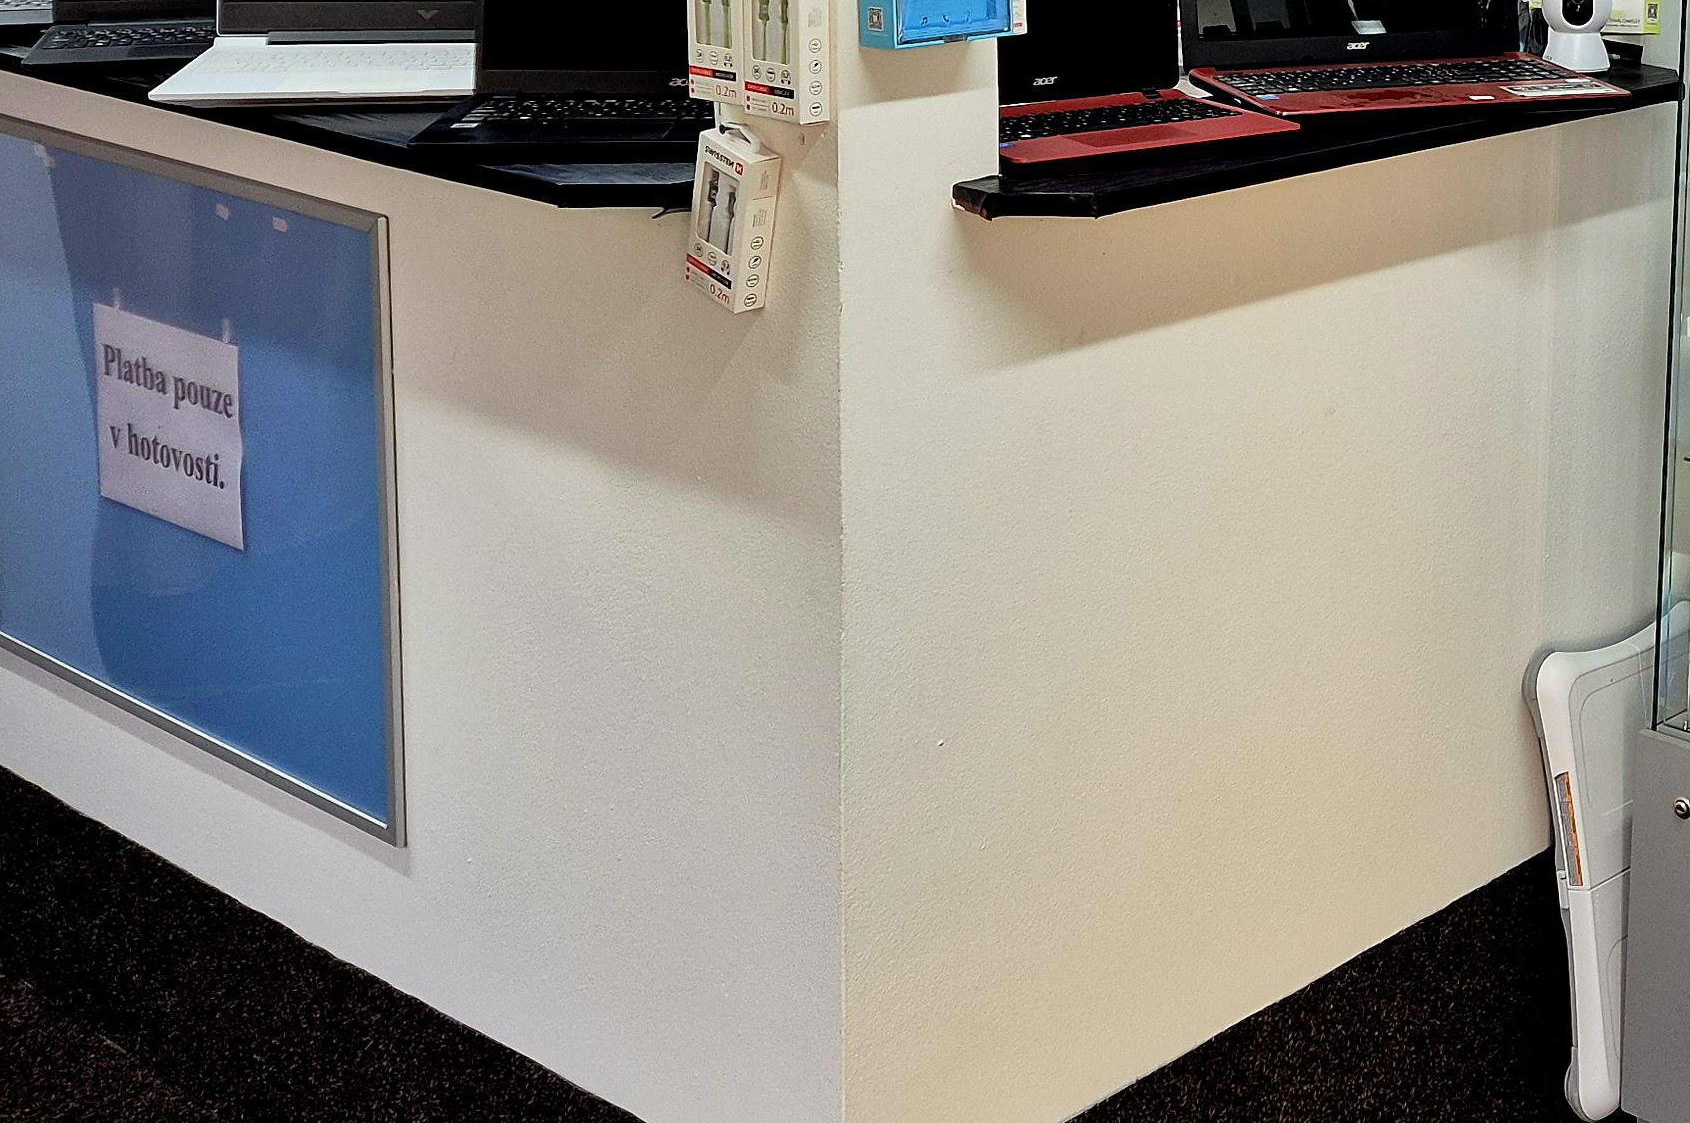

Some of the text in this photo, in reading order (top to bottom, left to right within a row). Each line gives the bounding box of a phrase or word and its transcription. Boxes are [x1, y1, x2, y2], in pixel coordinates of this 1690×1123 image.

[1347, 42, 1370, 51] acer
[1033, 76, 1058, 86] acer
[705, 145, 735, 169] SWISSTEN
[102, 343, 234, 419] Platba pouze
[109, 422, 226, 490] v hotovosti.
